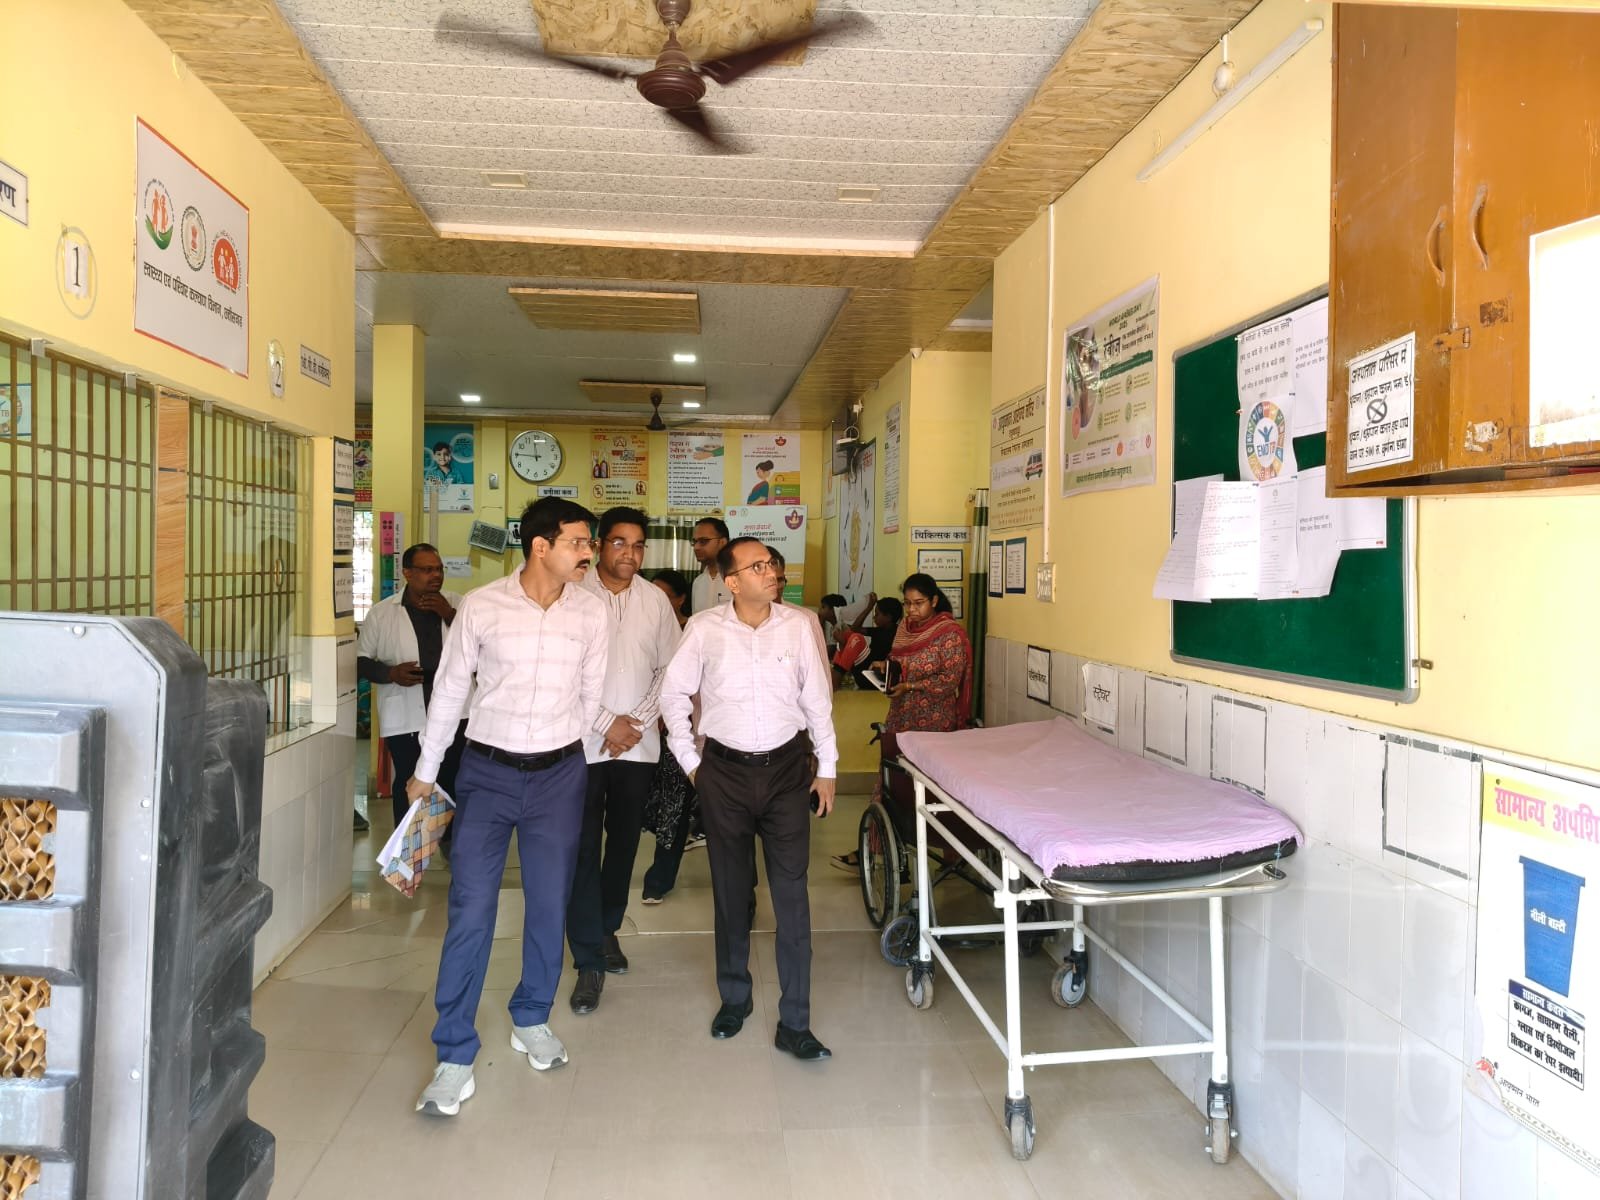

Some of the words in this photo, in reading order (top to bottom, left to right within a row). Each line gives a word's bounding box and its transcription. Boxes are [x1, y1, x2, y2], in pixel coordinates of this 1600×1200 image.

[1379, 350, 1399, 372] परिसर
[275, 360, 281, 389] 2
[914, 529, 951, 539] चिकित्सक
[953, 531, 967, 539] कक्ष
[1495, 786, 1546, 827] सामान्य
[1553, 803, 1600, 844] अपशि
[1530, 908, 1547, 925] नीली
[1535, 1029, 1545, 1043] एवं
[1534, 1047, 1543, 1061] का
